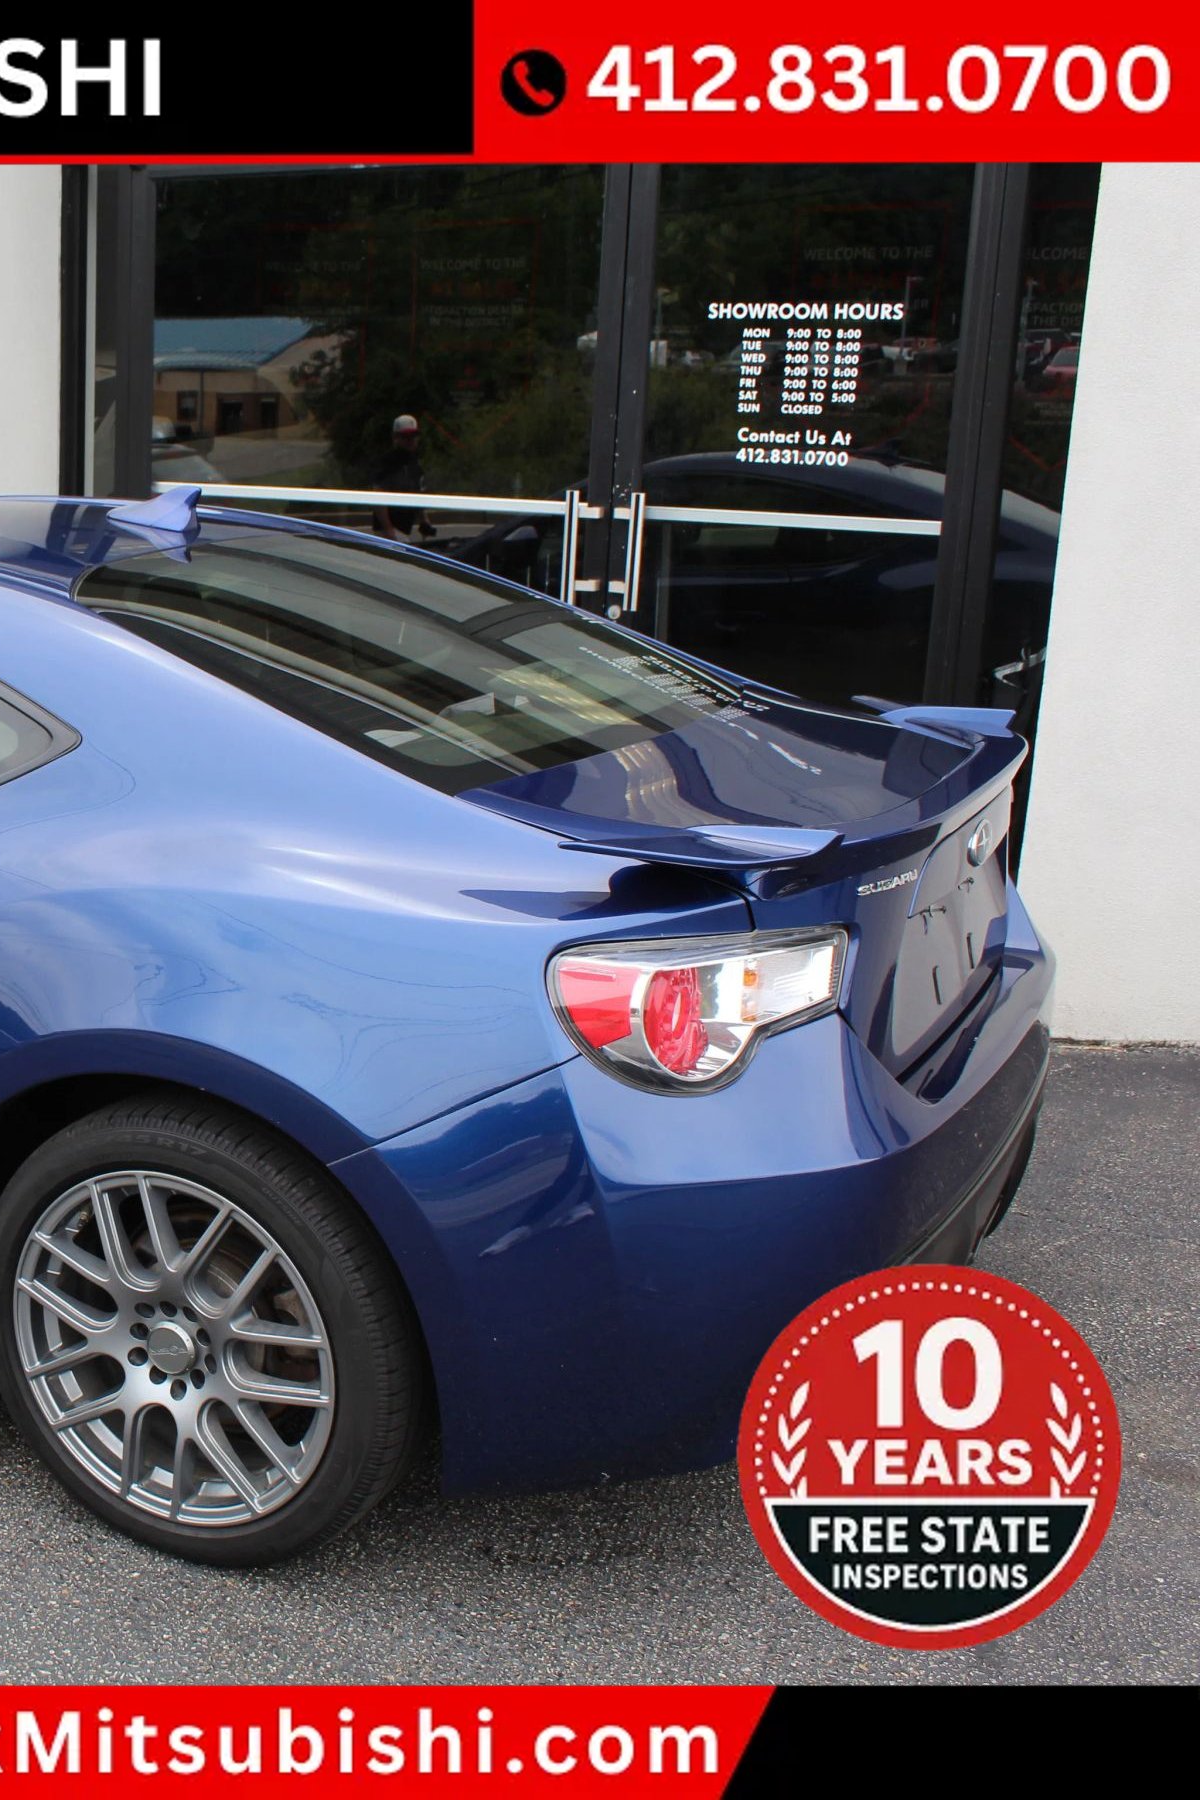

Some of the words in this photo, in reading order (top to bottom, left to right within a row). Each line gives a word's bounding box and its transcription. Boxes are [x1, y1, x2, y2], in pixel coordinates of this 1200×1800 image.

[707, 302, 829, 321] SHOWROOM
[834, 302, 905, 321] HOURS
[742, 327, 771, 339] MON
[786, 328, 812, 339] 9:00
[816, 328, 832, 339] TO
[836, 328, 862, 340] 8:00
[742, 340, 762, 351] TUE
[785, 340, 810, 352] 9:00
[814, 340, 830, 352] TO
[835, 341, 861, 352] 8:00
[741, 352, 767, 364] WED
[784, 353, 809, 364] 9:00
[813, 353, 830, 365] TO
[834, 353, 860, 365] 8:00
[740, 365, 762, 376] THU
[783, 365, 808, 377] 9:00
[813, 366, 829, 377] TO
[833, 366, 858, 378] 8:00
[739, 377, 756, 388] FRI
[783, 378, 807, 390] 9:00
[811, 379, 827, 390] TO
[831, 379, 857, 391] 6:00
[738, 390, 758, 401] SAT
[781, 391, 806, 402] 9:00
[809, 391, 825, 403] TO
[831, 392, 856, 403] 5:00
[737, 402, 761, 414] SUN
[781, 403, 823, 415] CLOSED
[737, 427, 801, 444] Contact
[805, 429, 826, 445] Us
[831, 430, 852, 446] At
[735, 448, 849, 467] 412.831.0700
[856, 868, 918, 896] SUBARU
